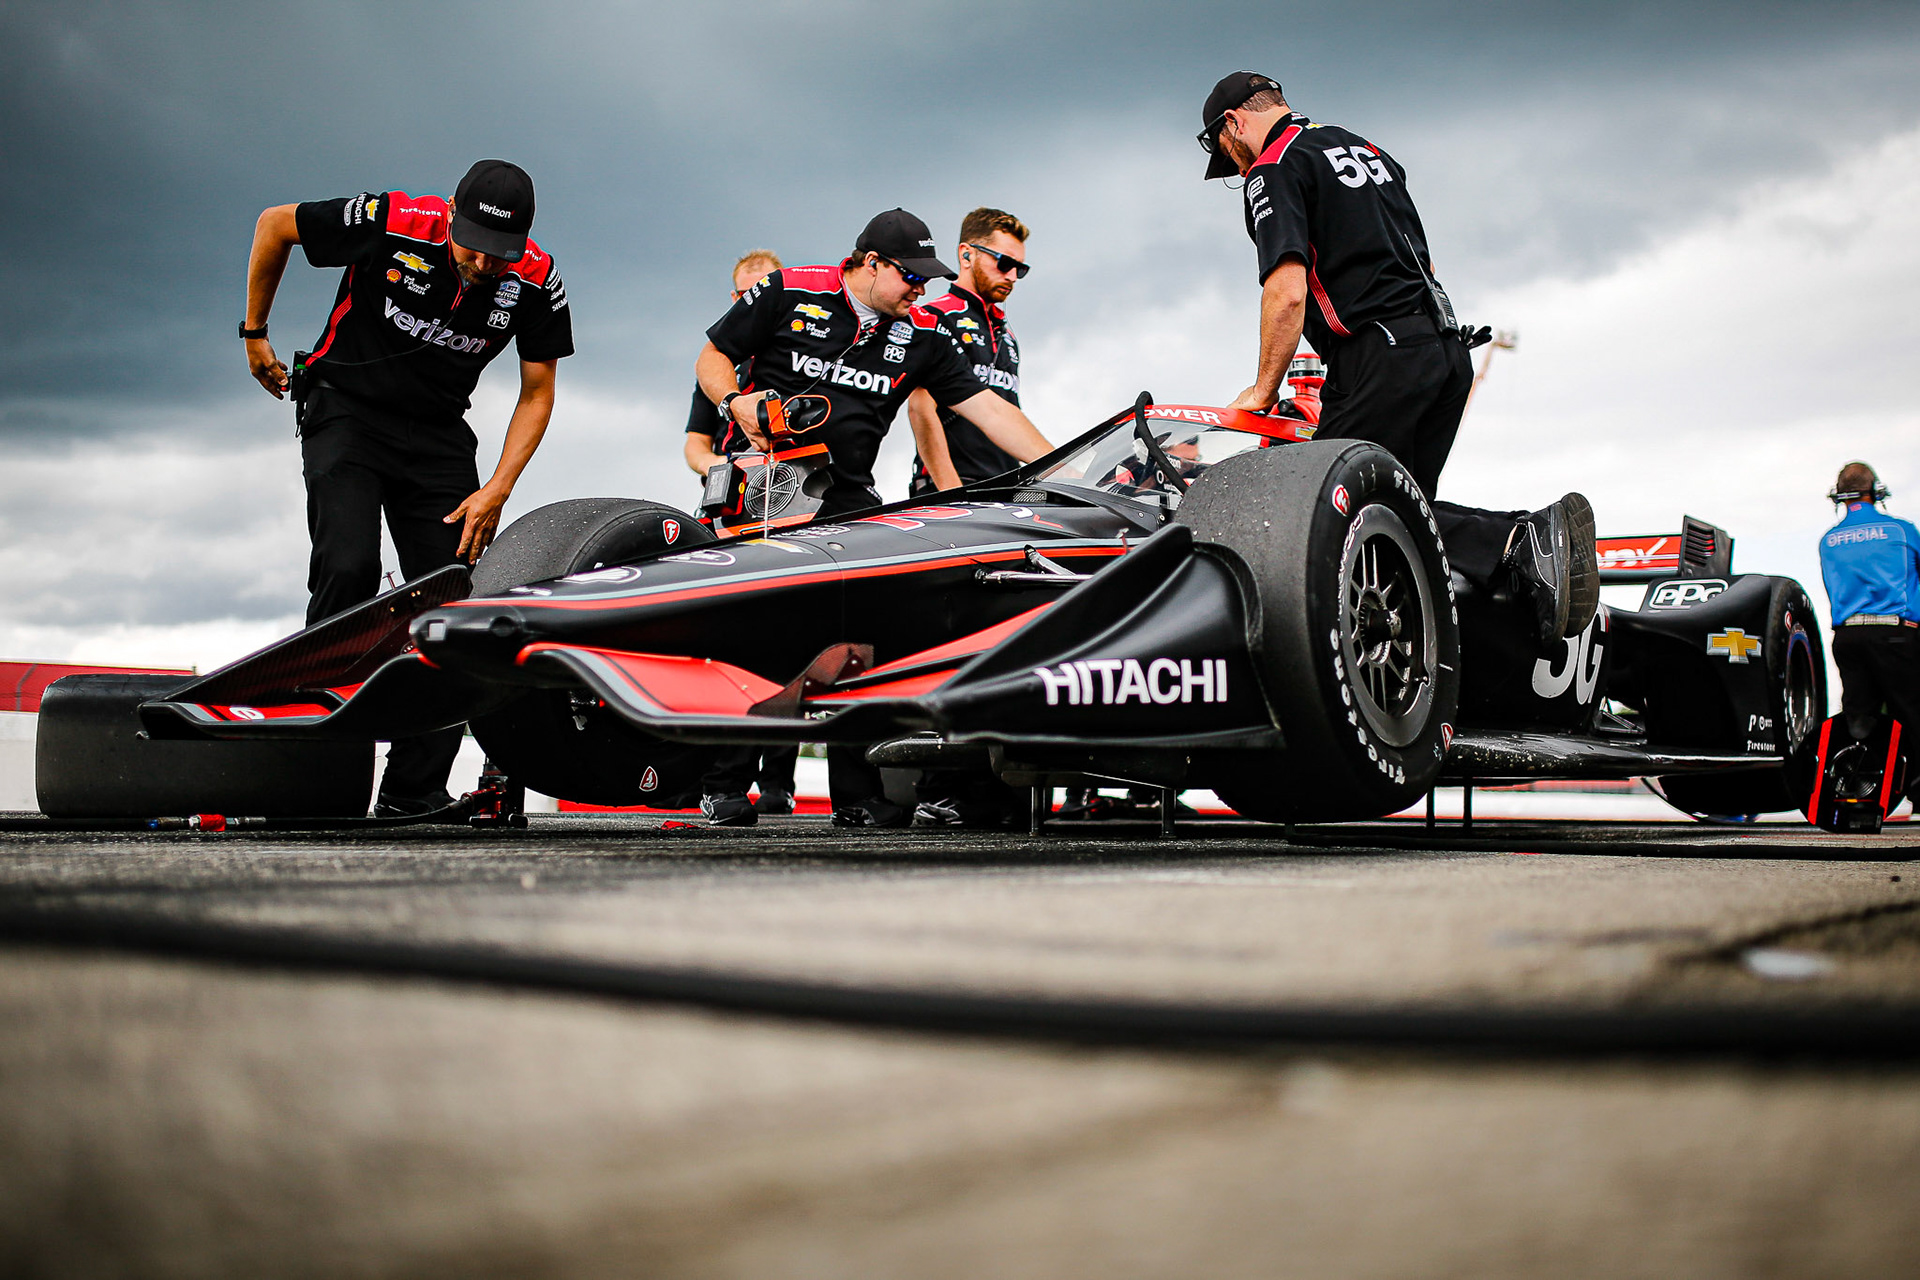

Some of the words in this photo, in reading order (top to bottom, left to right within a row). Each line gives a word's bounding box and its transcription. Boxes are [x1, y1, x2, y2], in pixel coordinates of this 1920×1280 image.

[1322, 146, 1393, 188] 5G
[479, 202, 512, 219] verizon
[384, 296, 486, 354] verizon
[489, 311, 509, 326] PPG
[791, 350, 892, 395] verizon
[885, 347, 903, 361] PPG
[1143, 408, 1222, 425] OWER
[1394, 470, 1458, 626] Firestone
[1826, 527, 1889, 547] OFFICIAL
[1033, 657, 1228, 706] HITACHI
[1330, 628, 1406, 785] Firestone
